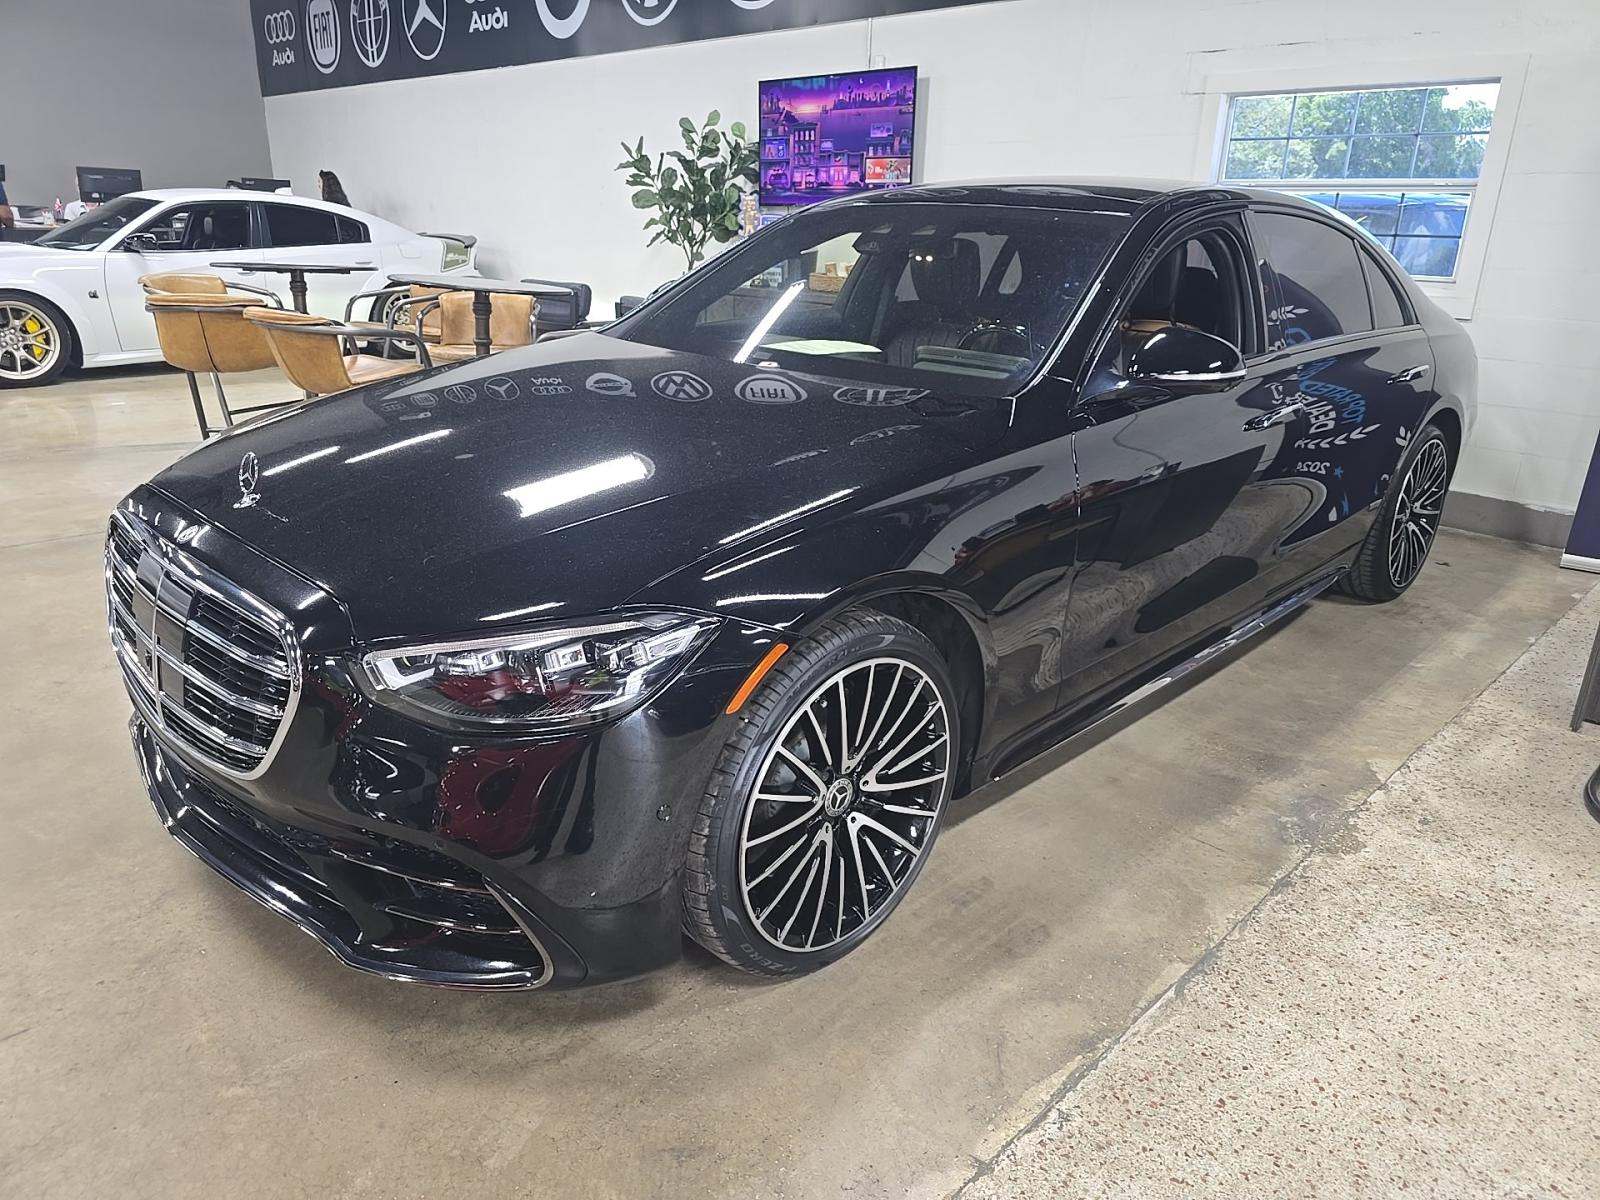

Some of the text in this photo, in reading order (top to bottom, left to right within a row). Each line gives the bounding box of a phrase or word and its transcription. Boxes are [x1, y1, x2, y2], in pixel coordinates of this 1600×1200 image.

[313, 10, 333, 50] FIAT
[469, 7, 508, 33] Audi
[272, 47, 295, 66] Audi
